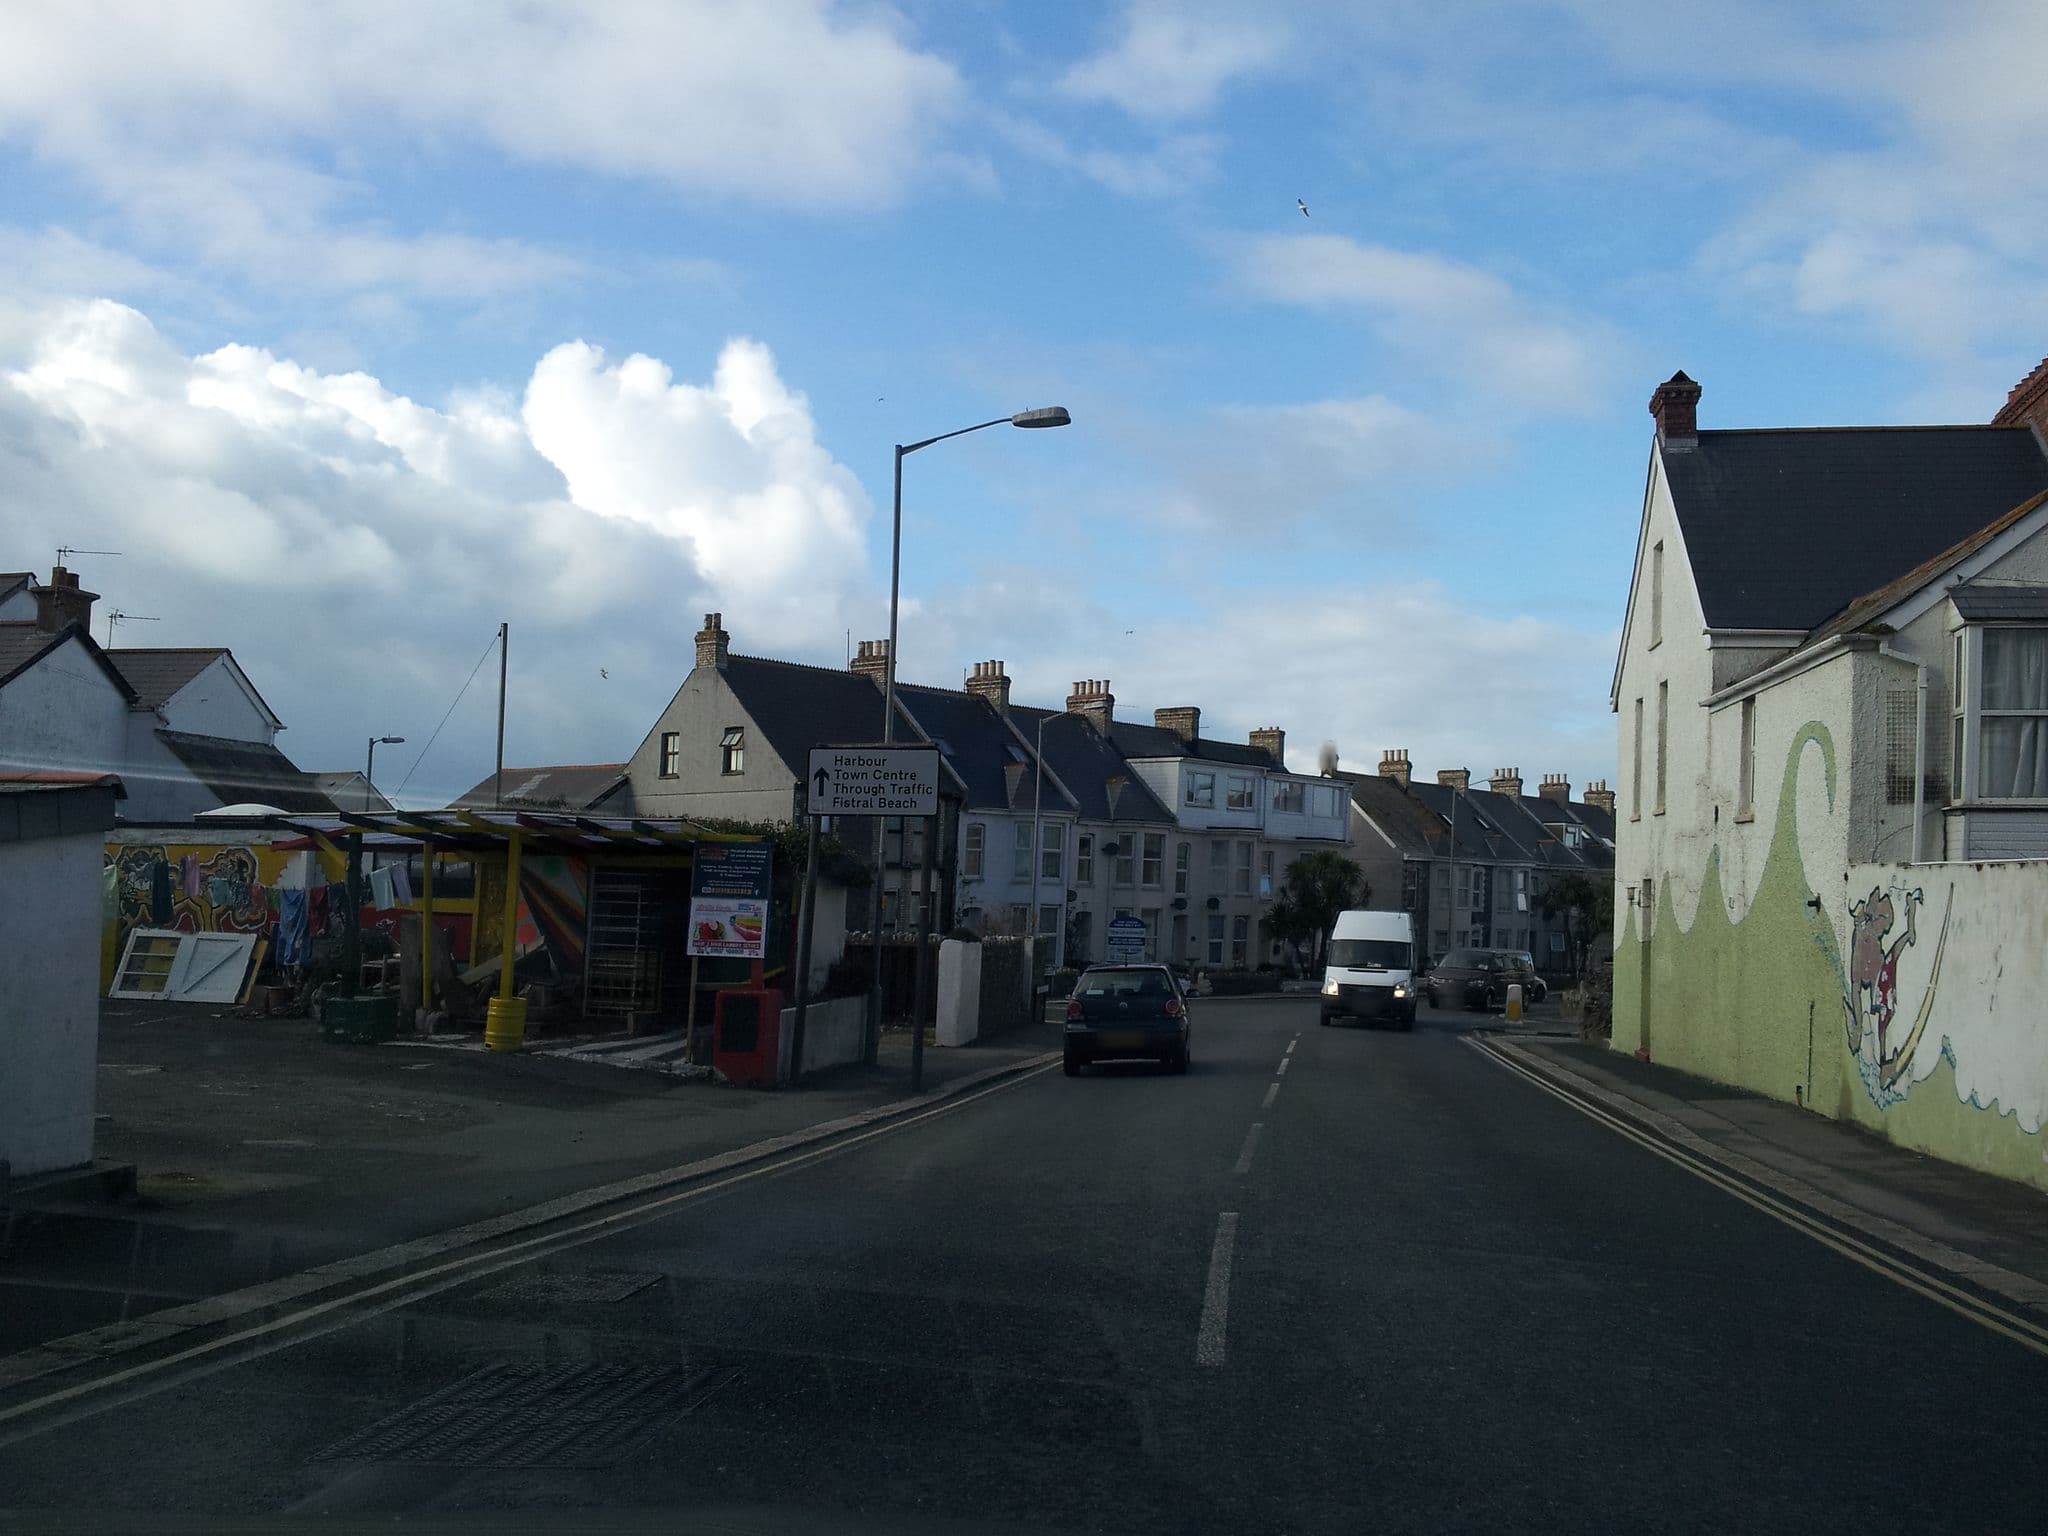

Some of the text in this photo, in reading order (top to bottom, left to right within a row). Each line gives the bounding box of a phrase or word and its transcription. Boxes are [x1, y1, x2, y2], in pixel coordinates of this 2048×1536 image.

[834, 756, 887, 767] Harbour
[834, 769, 917, 781] Town Centre
[833, 783, 933, 796] Through Traffic
[832, 797, 917, 809] Fistral Beach
